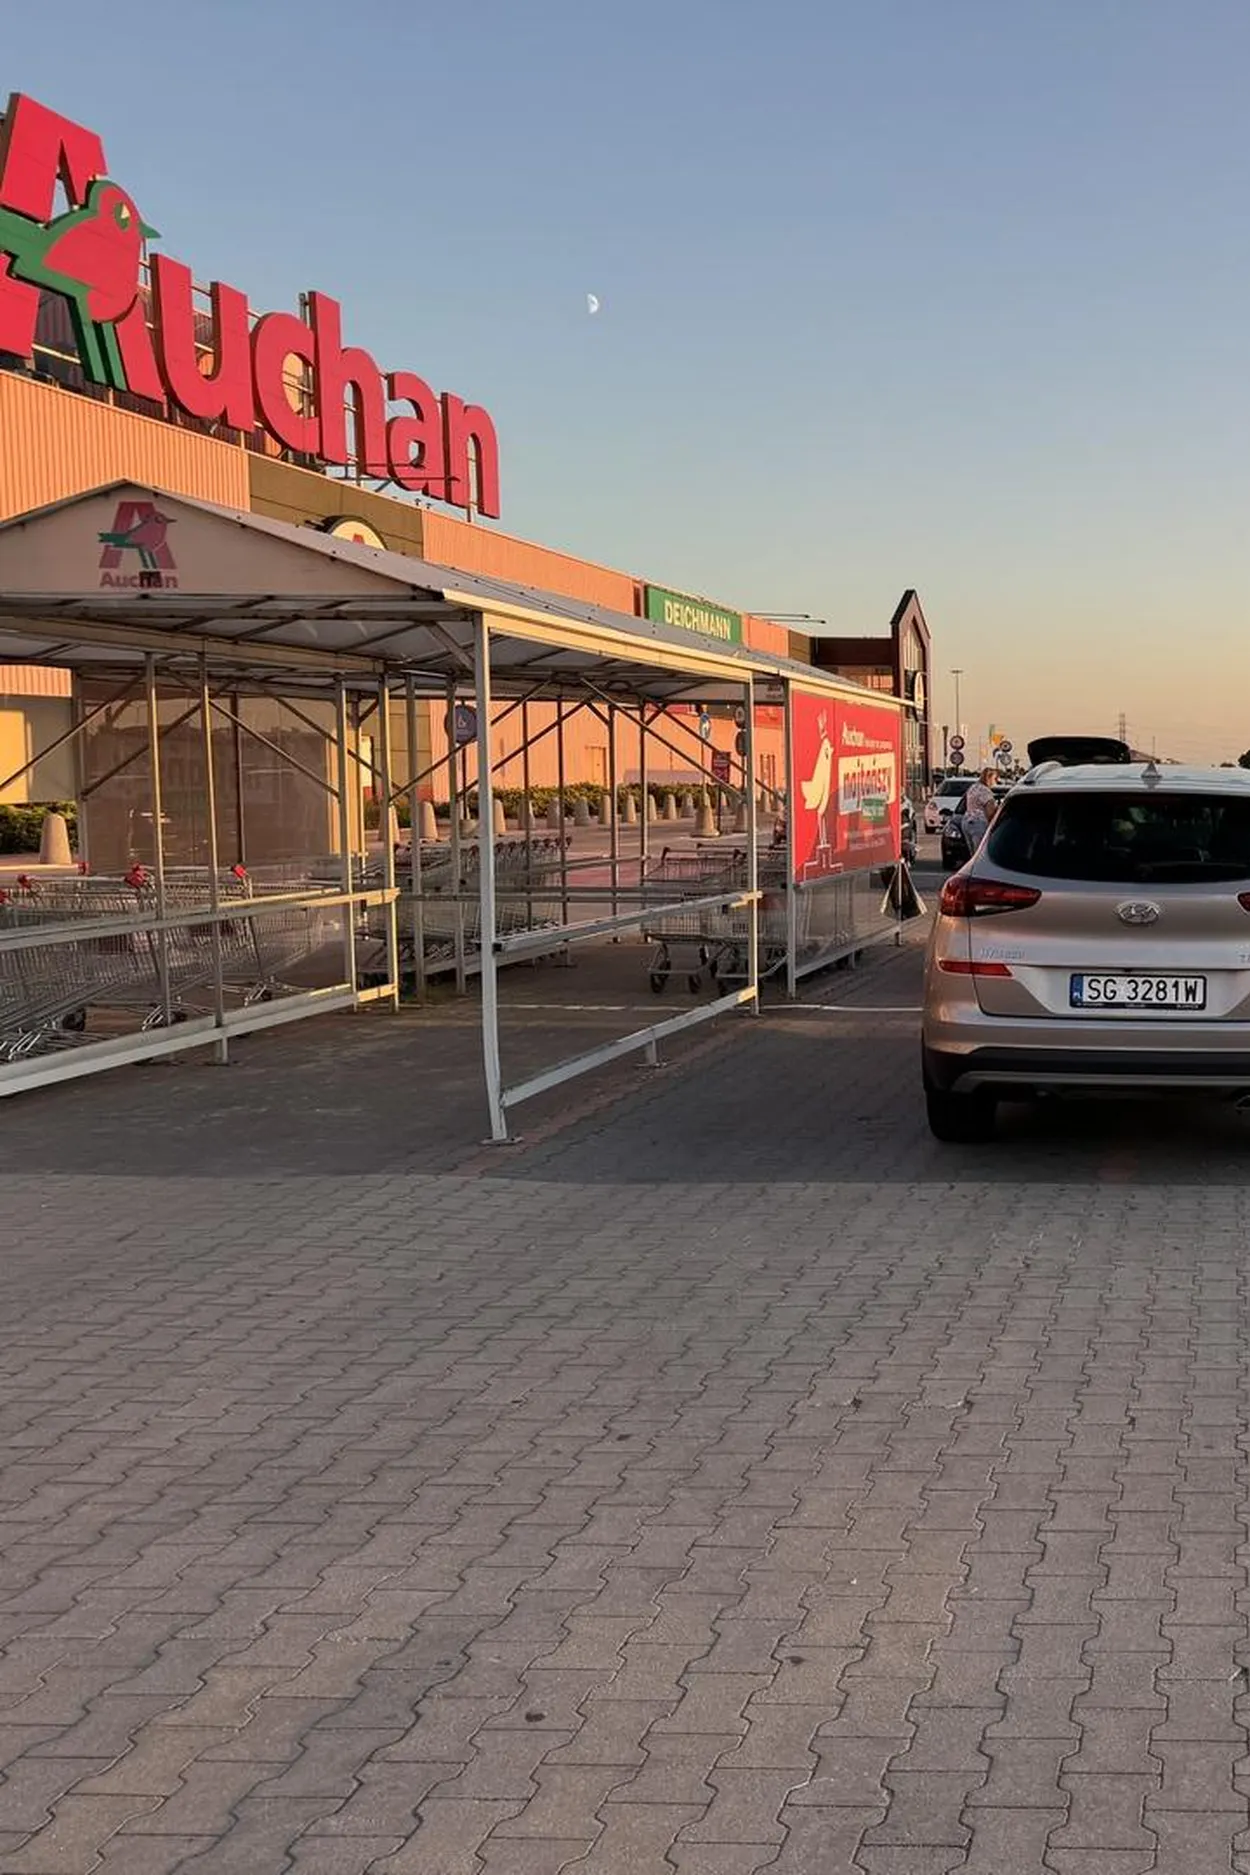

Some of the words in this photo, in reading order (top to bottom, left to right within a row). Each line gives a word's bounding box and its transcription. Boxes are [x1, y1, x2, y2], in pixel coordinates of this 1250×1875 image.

[0, 92, 500, 520] Auchan
[100, 571, 178, 588] Auchan
[664, 600, 731, 640] DEICHMANN
[1088, 979, 1117, 1000] SG
[1126, 979, 1198, 1002] 3281W
